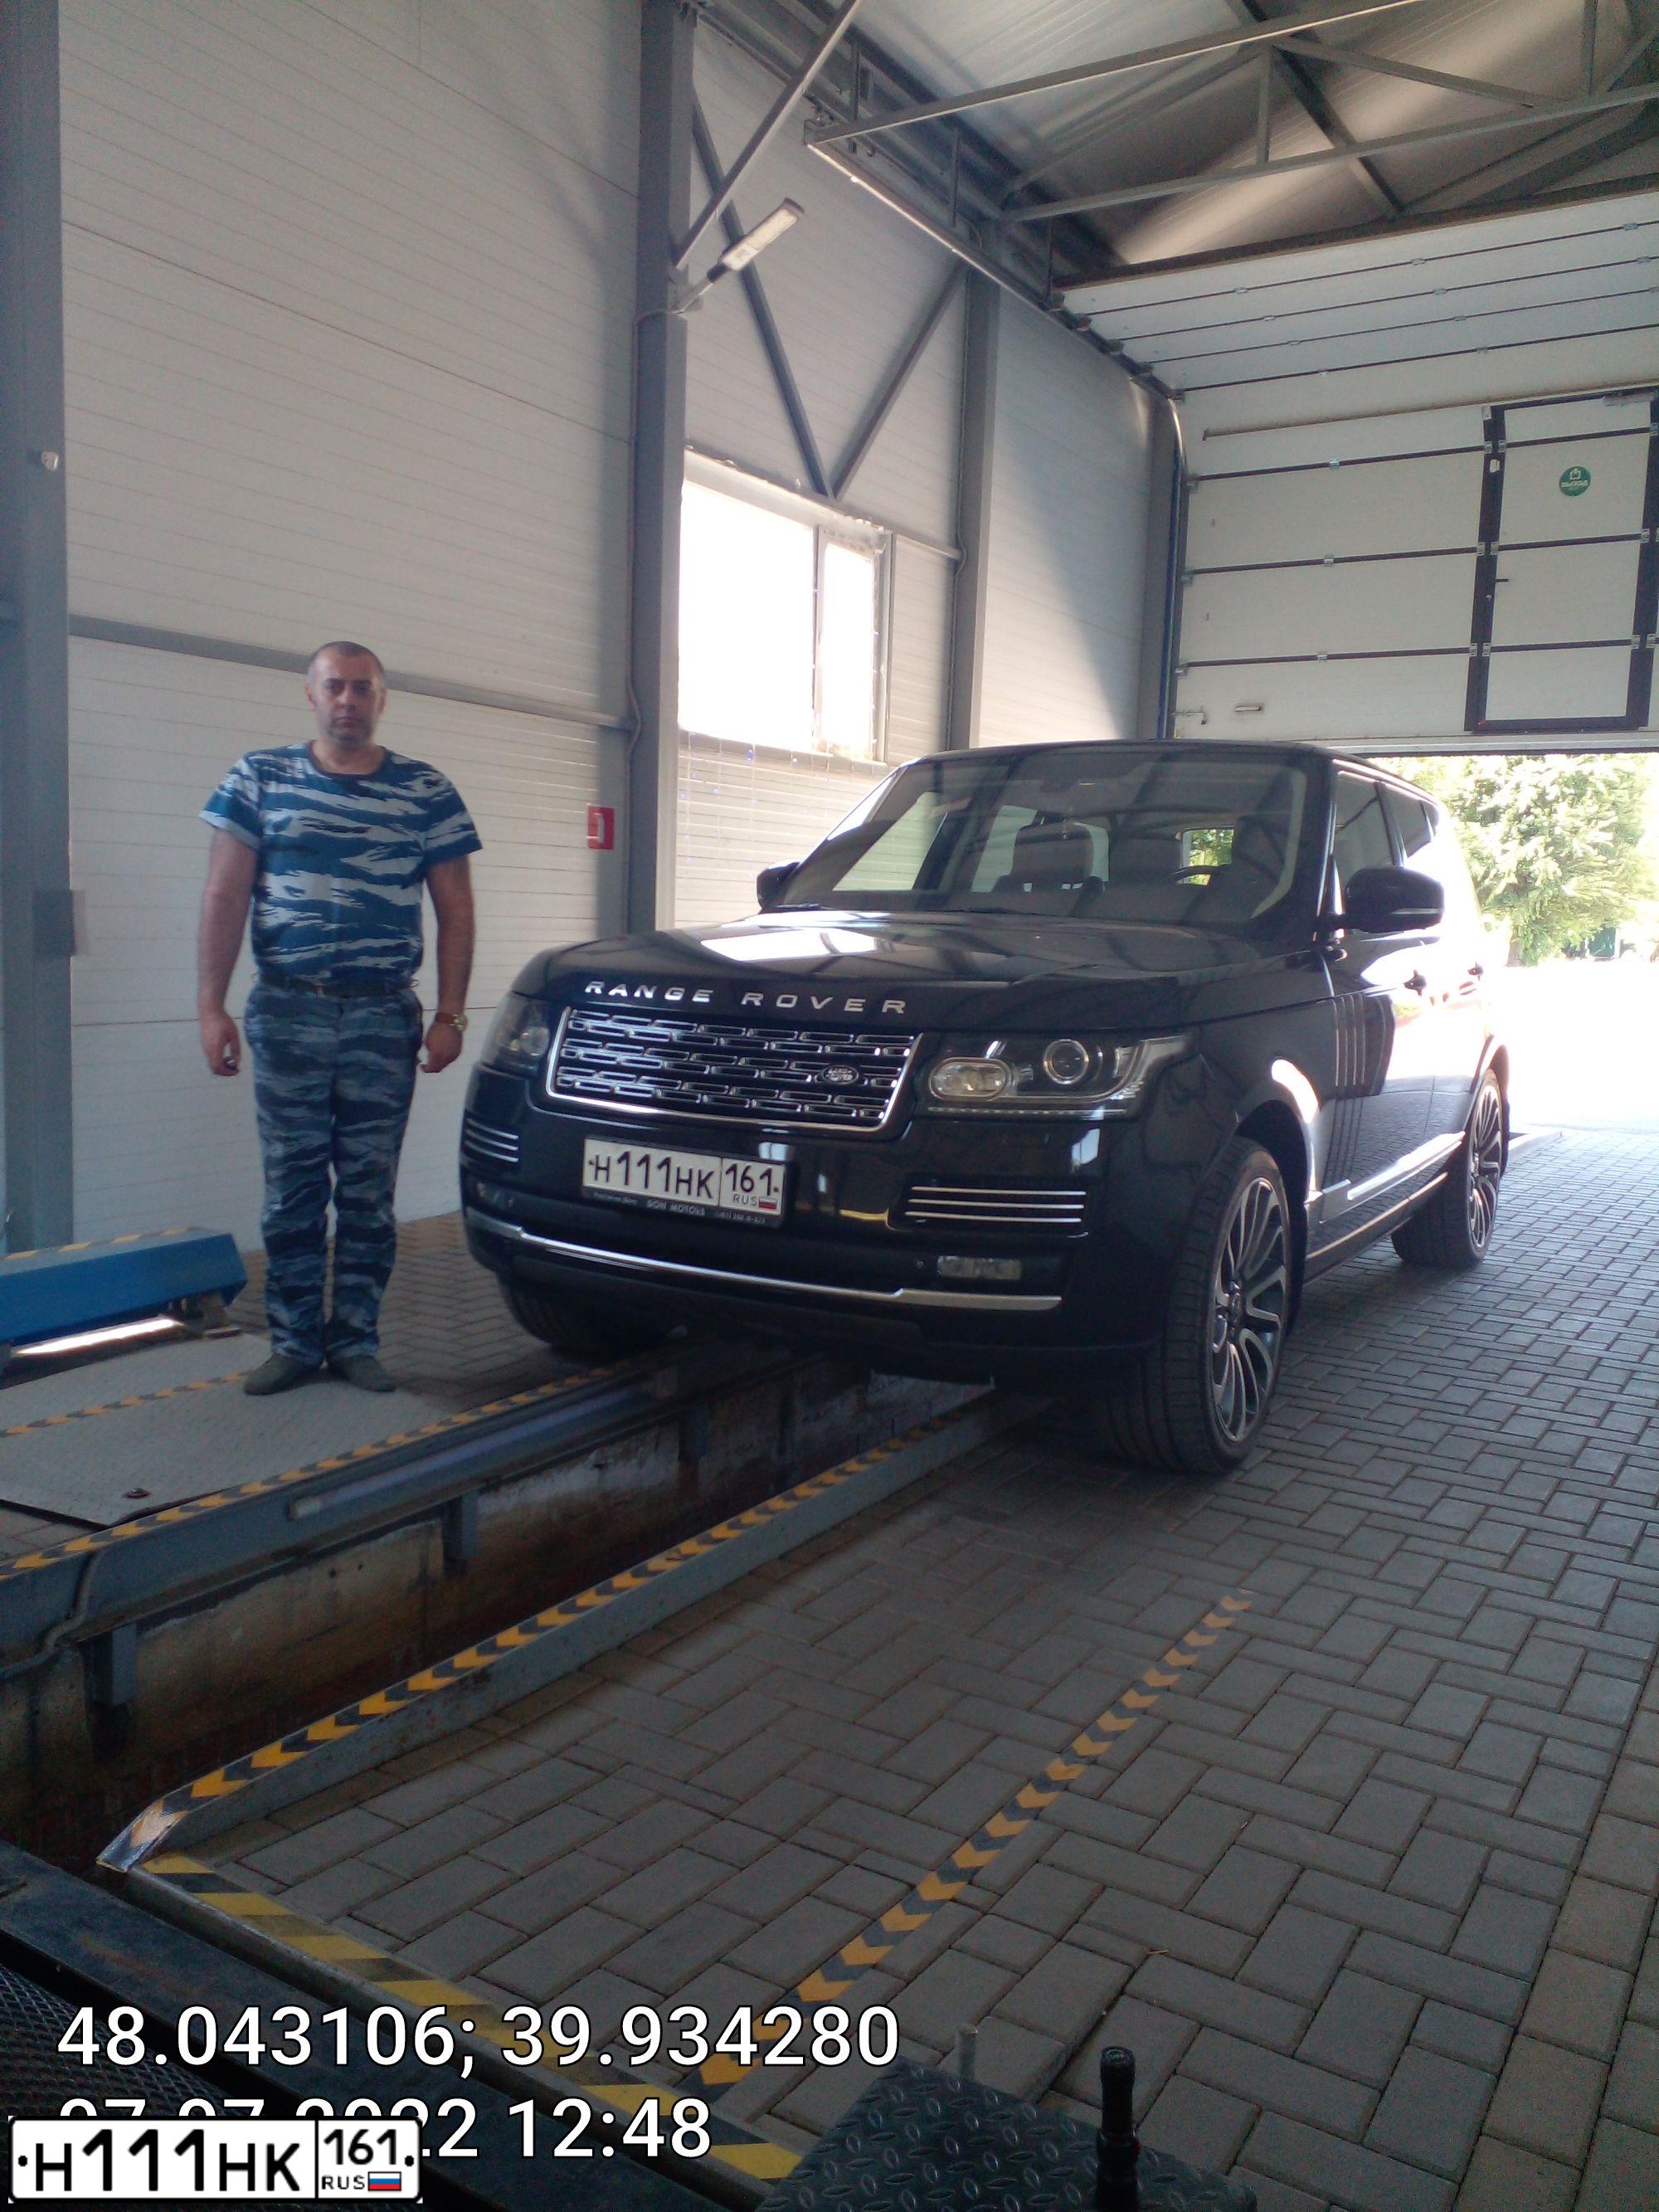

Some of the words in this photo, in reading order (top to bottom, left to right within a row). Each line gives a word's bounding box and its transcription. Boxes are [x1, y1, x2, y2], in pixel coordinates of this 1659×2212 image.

[585, 980, 714, 1003] RANGE
[741, 992, 907, 1014] ROVER
[725, 1162, 774, 1196] 161
[732, 1193, 758, 1207] RUS
